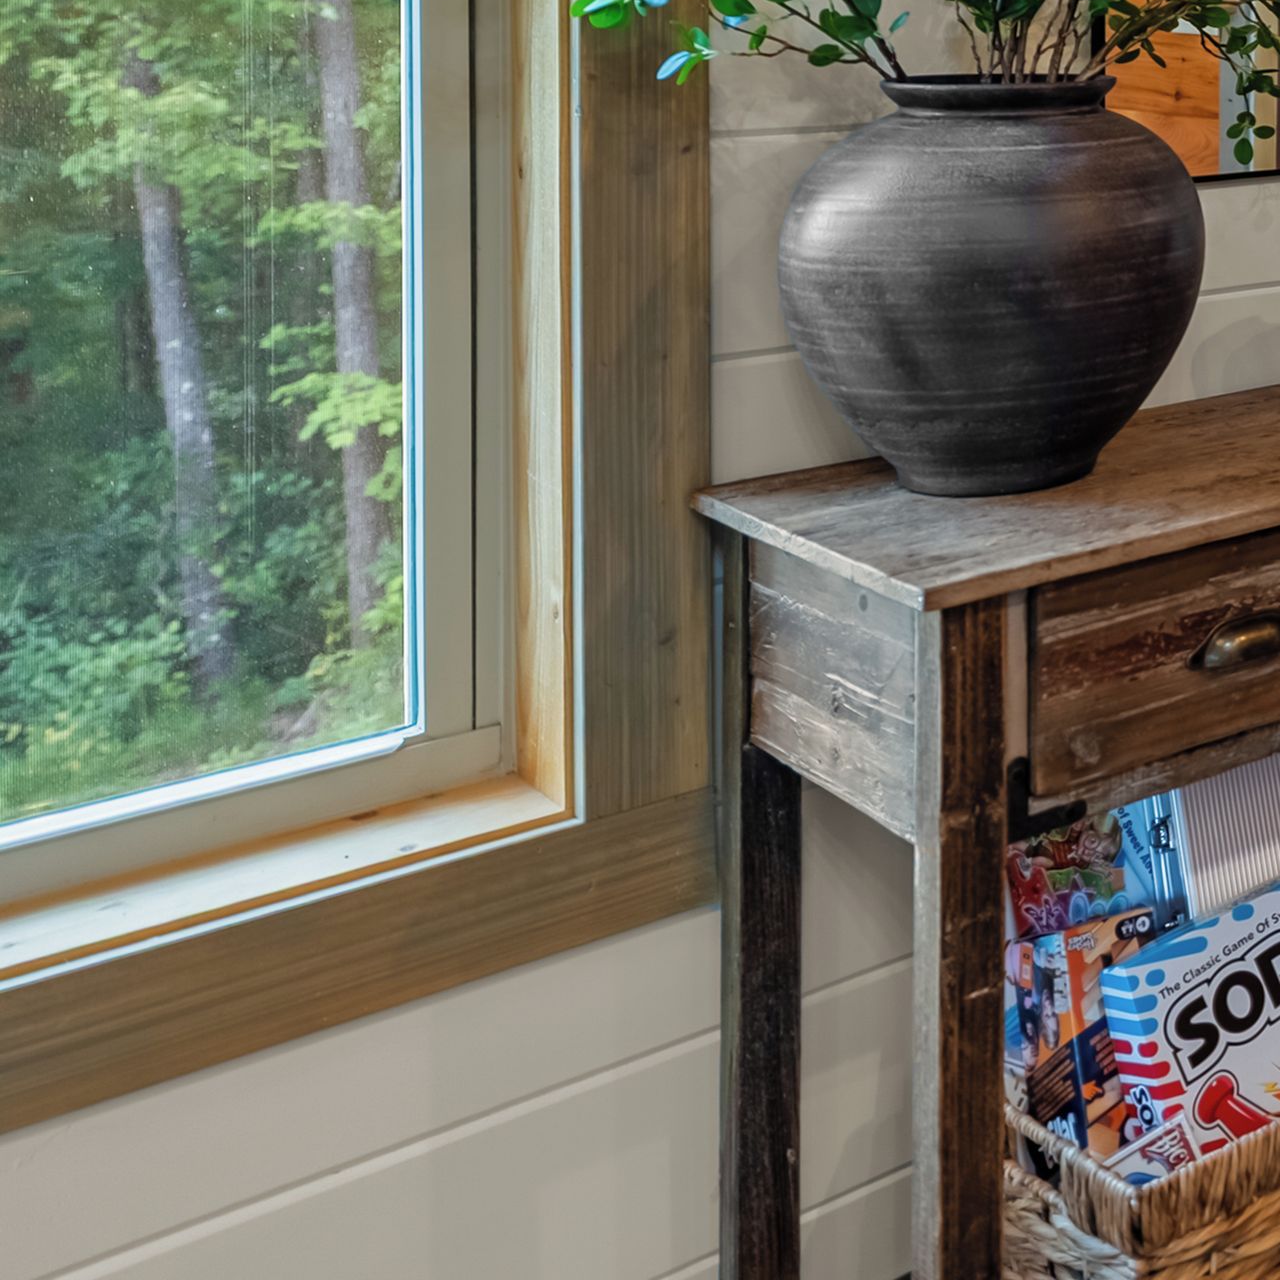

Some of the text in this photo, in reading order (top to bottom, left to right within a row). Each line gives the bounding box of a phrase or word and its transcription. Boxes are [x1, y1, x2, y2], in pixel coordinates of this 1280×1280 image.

[1158, 981, 1181, 1000] The
[1182, 953, 1221, 984] Classic
[1222, 931, 1254, 957] Game
[1255, 916, 1272, 935] Of
